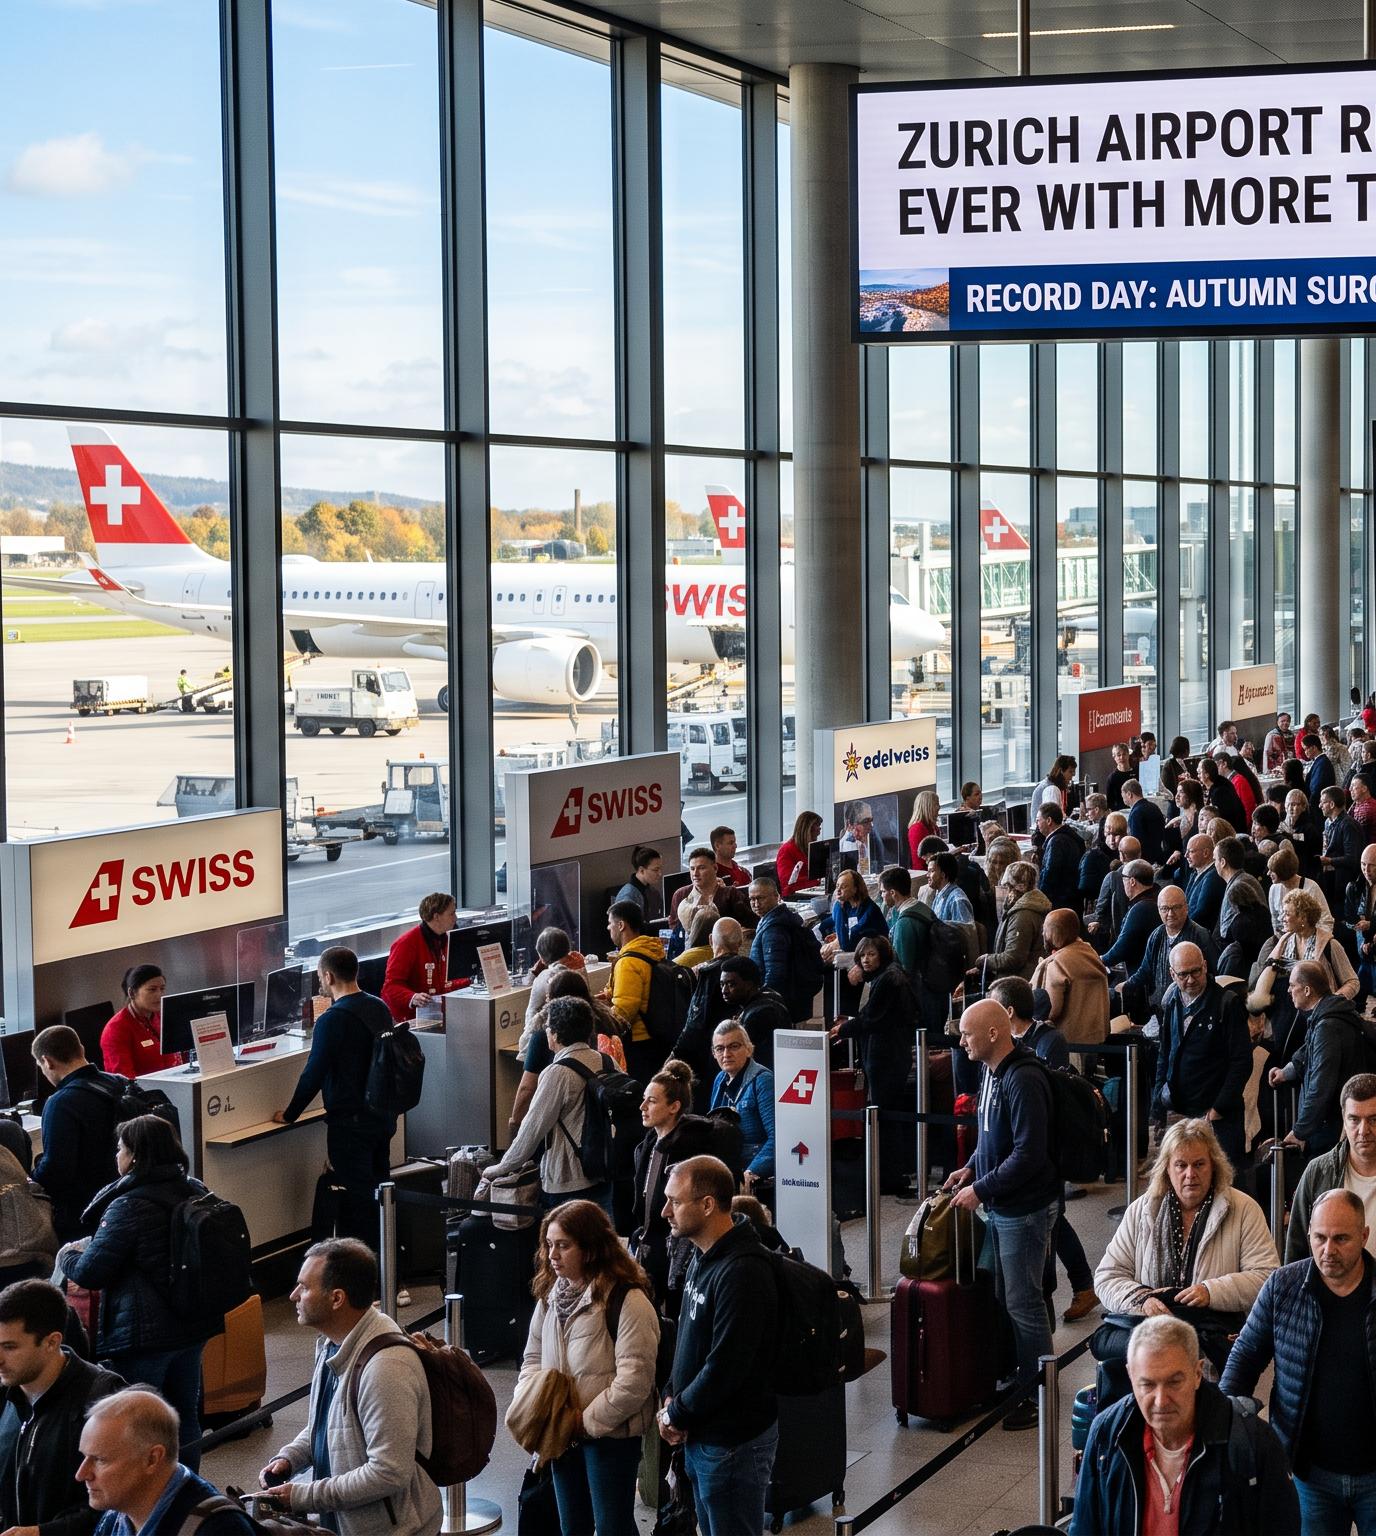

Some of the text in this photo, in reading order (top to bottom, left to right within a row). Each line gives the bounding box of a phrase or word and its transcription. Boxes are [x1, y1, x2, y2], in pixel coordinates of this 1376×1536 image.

[897, 115, 1080, 170] ZURICH
[1095, 105, 1323, 163] AIRPORT
[899, 185, 1022, 236] EVER
[1036, 180, 1165, 231] WITH
[1184, 174, 1332, 227] MORE
[966, 282, 1082, 313] RECORD
[1091, 280, 1157, 310] DAY:
[1165, 276, 1297, 308] AUTUMN
[863, 744, 930, 770] edelweiss
[587, 782, 663, 824] SWISS
[131, 849, 255, 906] SWISS
